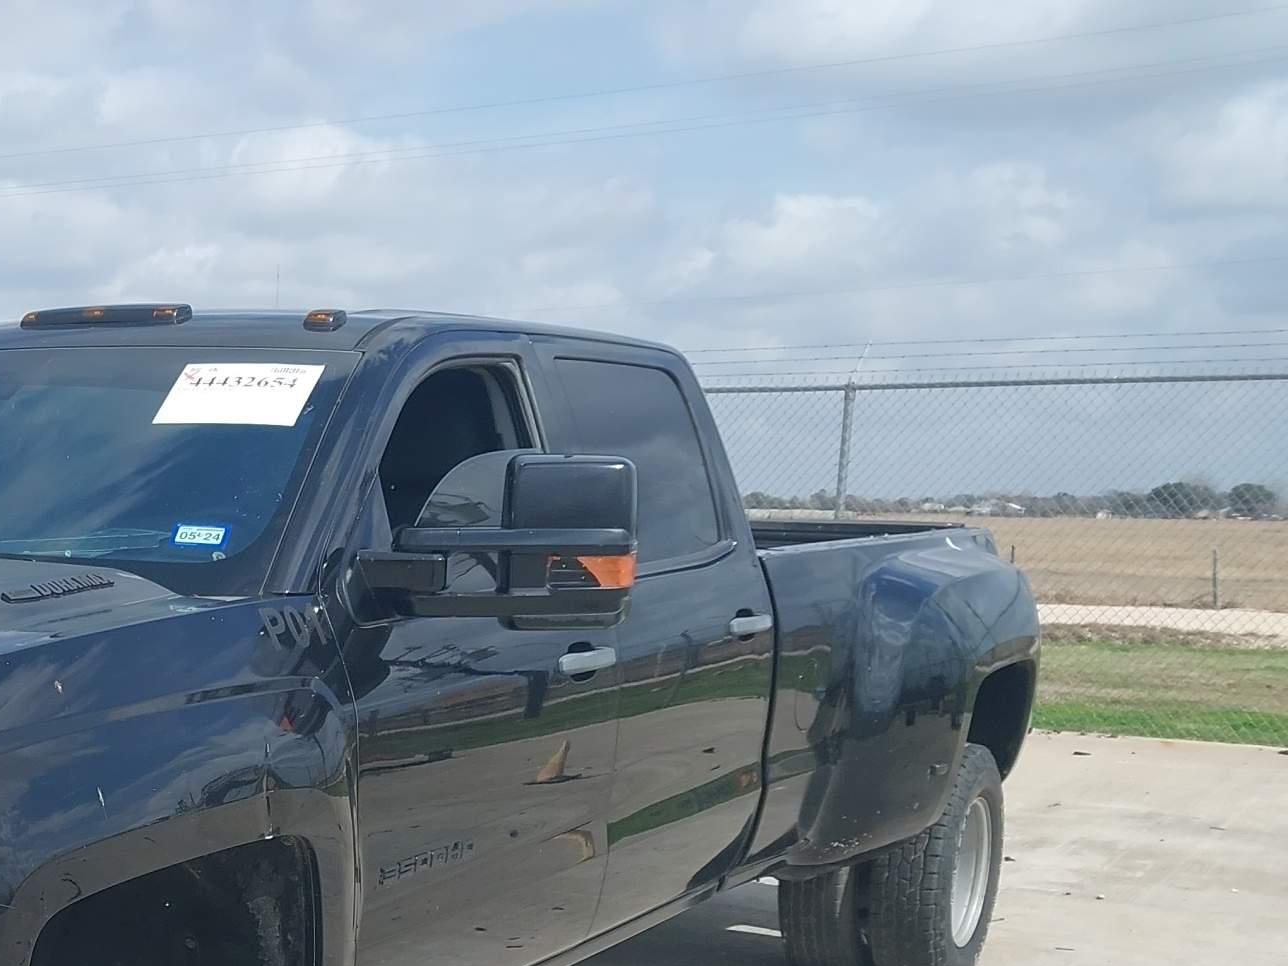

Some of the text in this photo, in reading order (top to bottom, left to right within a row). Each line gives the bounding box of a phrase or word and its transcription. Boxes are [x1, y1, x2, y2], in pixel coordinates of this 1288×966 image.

[189, 376, 299, 389] 44432654
[179, 531, 221, 542] 05 24
